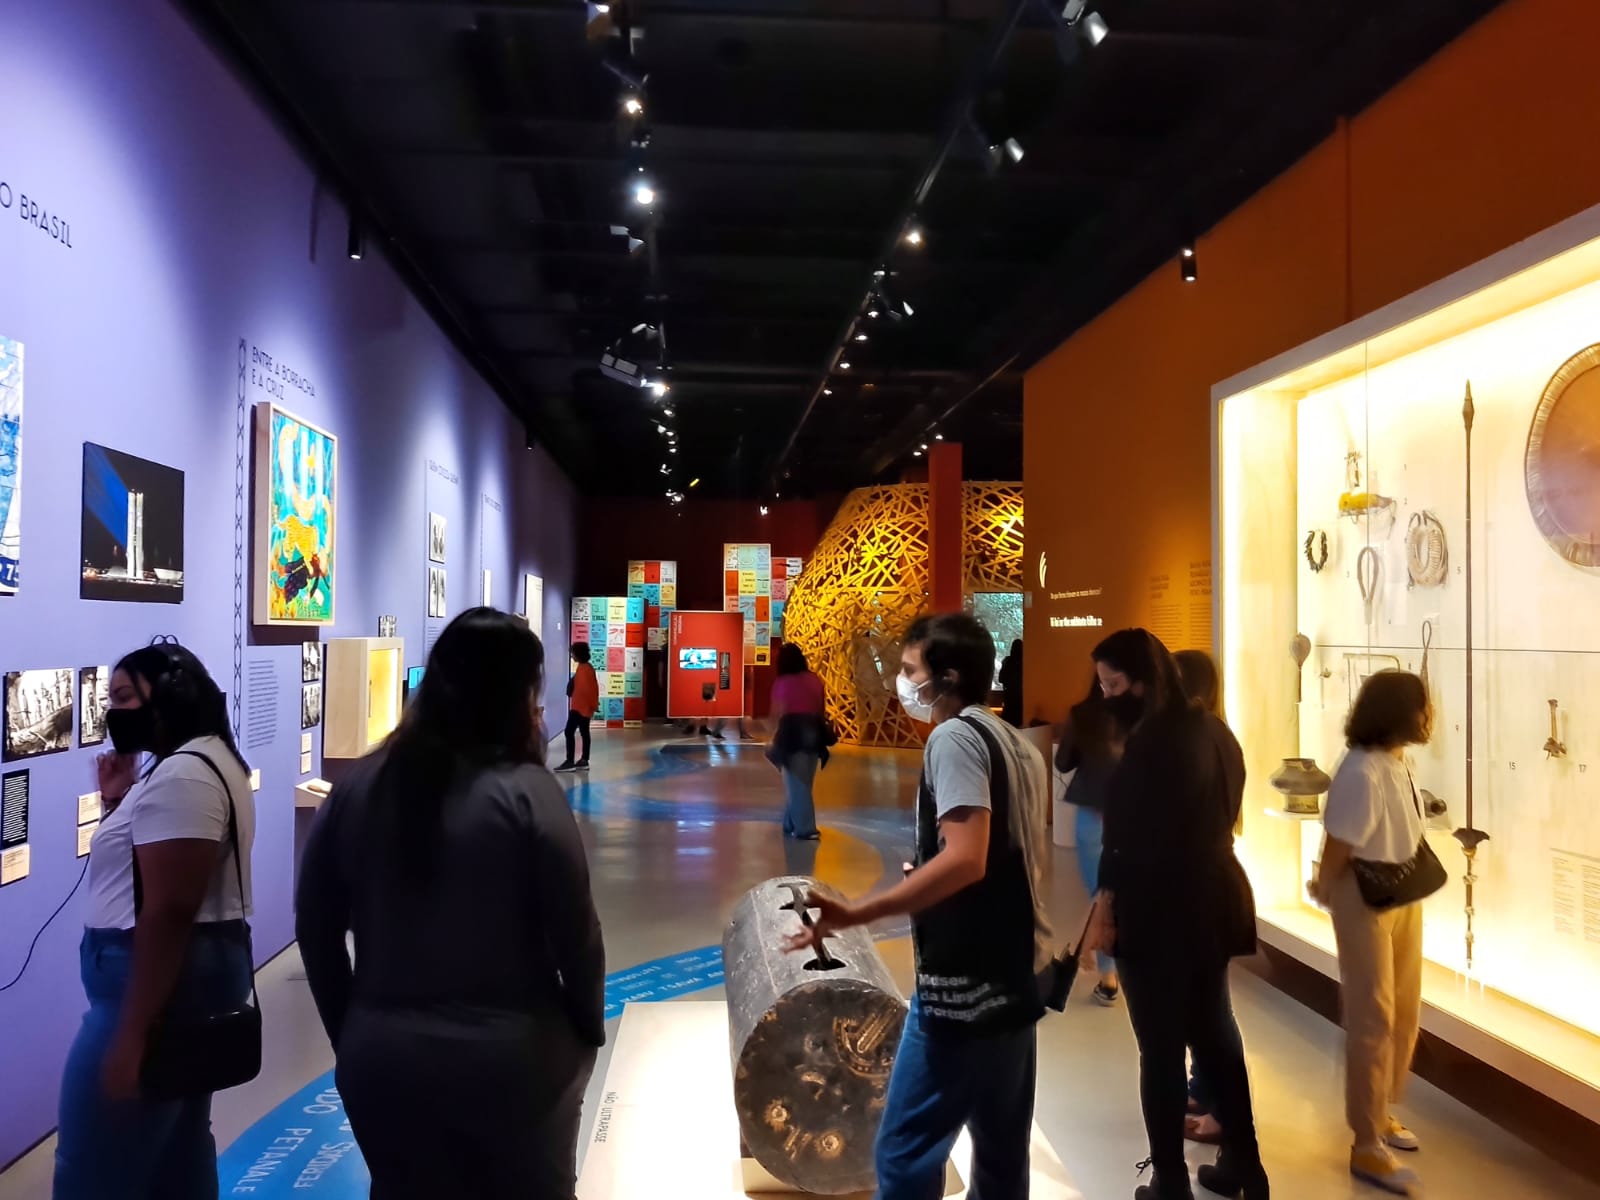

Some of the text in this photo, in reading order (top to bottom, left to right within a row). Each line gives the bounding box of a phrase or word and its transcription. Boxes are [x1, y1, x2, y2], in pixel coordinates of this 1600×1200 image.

[20, 193, 72, 249] BRASIL
[252, 345, 316, 397] ENTRE A BORRACHA
[252, 368, 284, 401] E A CRUZ
[1508, 761, 1516, 771] 15
[1578, 764, 1587, 773] 17
[918, 973, 968, 987] Museu
[920, 990, 939, 1002] da
[593, 1091, 619, 1143] NÃO ULTRAPASSE
[231, 1127, 313, 1193] PETANALE
